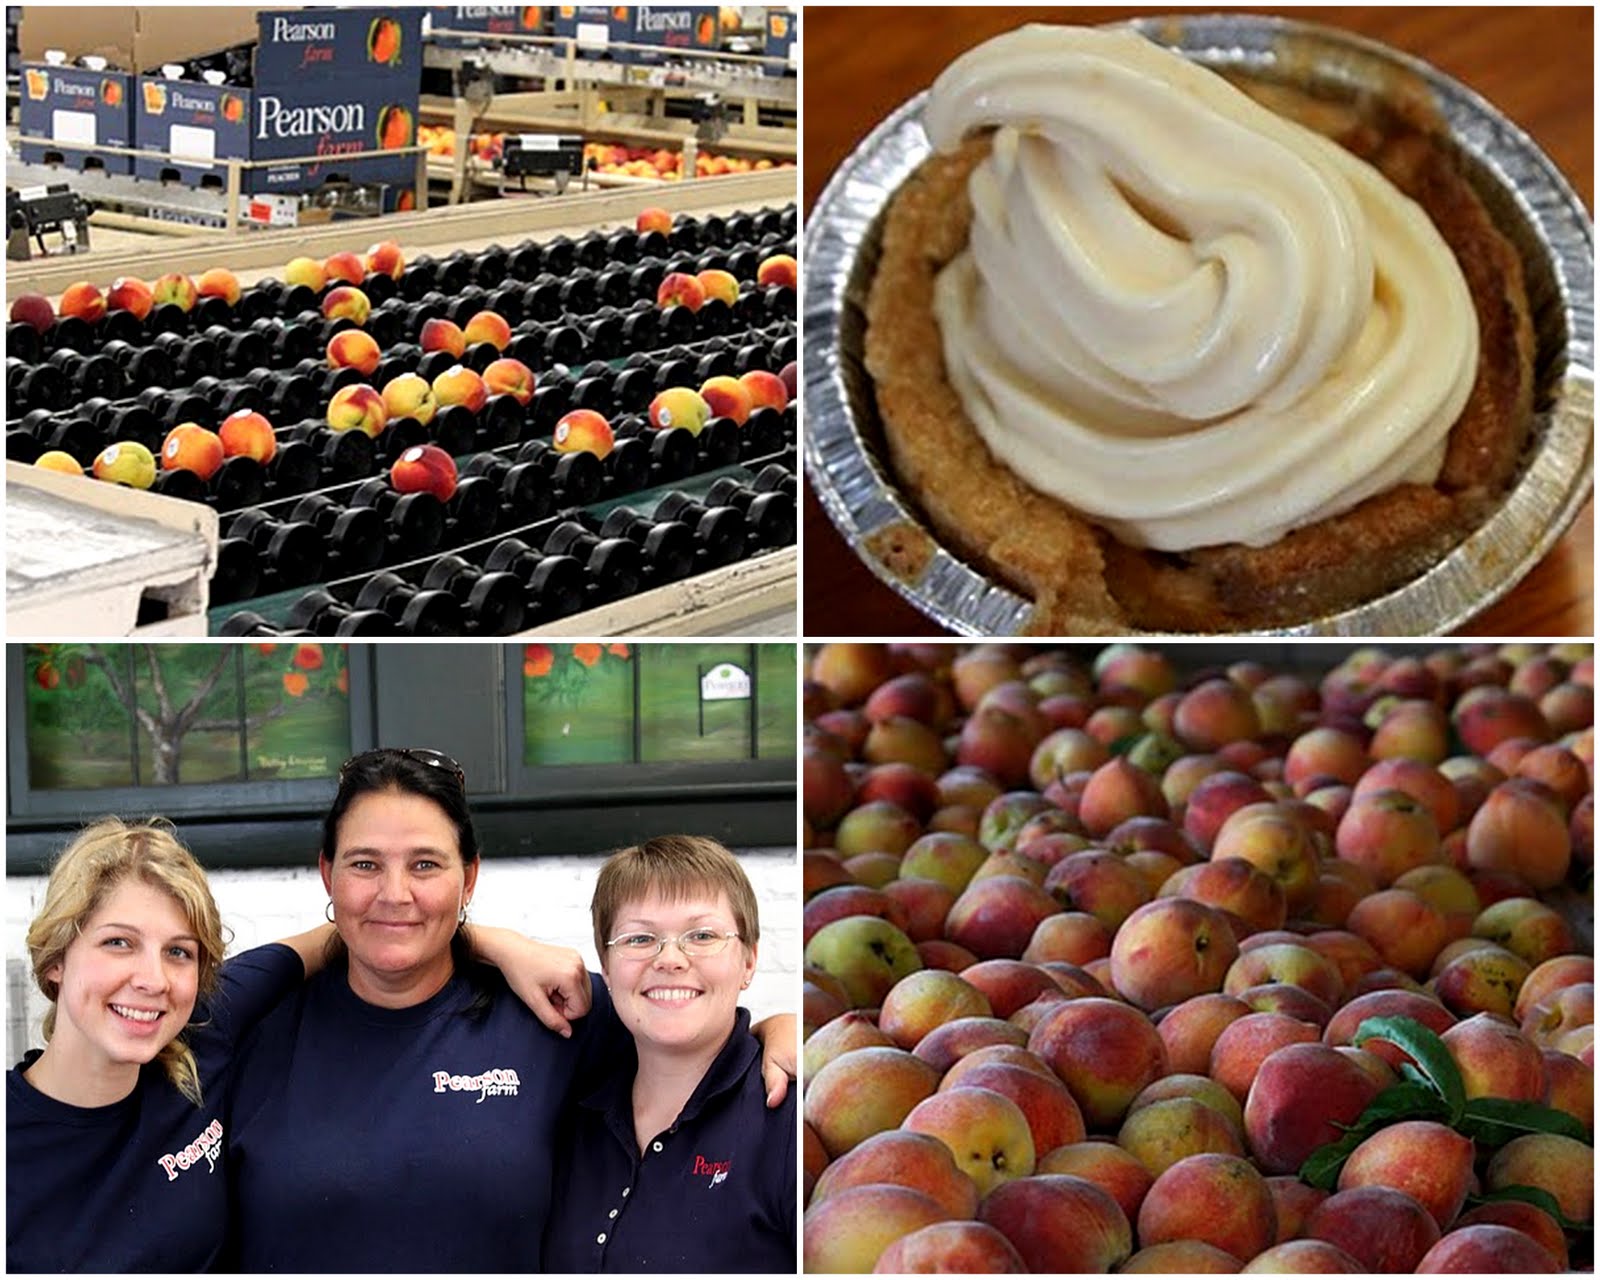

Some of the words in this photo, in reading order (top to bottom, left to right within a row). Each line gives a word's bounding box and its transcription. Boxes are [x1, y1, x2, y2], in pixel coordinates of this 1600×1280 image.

[272, 17, 336, 42] Pearson
[636, 6, 692, 32] Pearson
[256, 96, 365, 139] Pearson
[308, 133, 364, 177] farm
[432, 1068, 520, 1093] Pearson
[475, 1084, 518, 1104] farm
[157, 1118, 223, 1182] Pearson
[205, 1139, 222, 1174] far
[692, 1154, 732, 1176] Pearso
